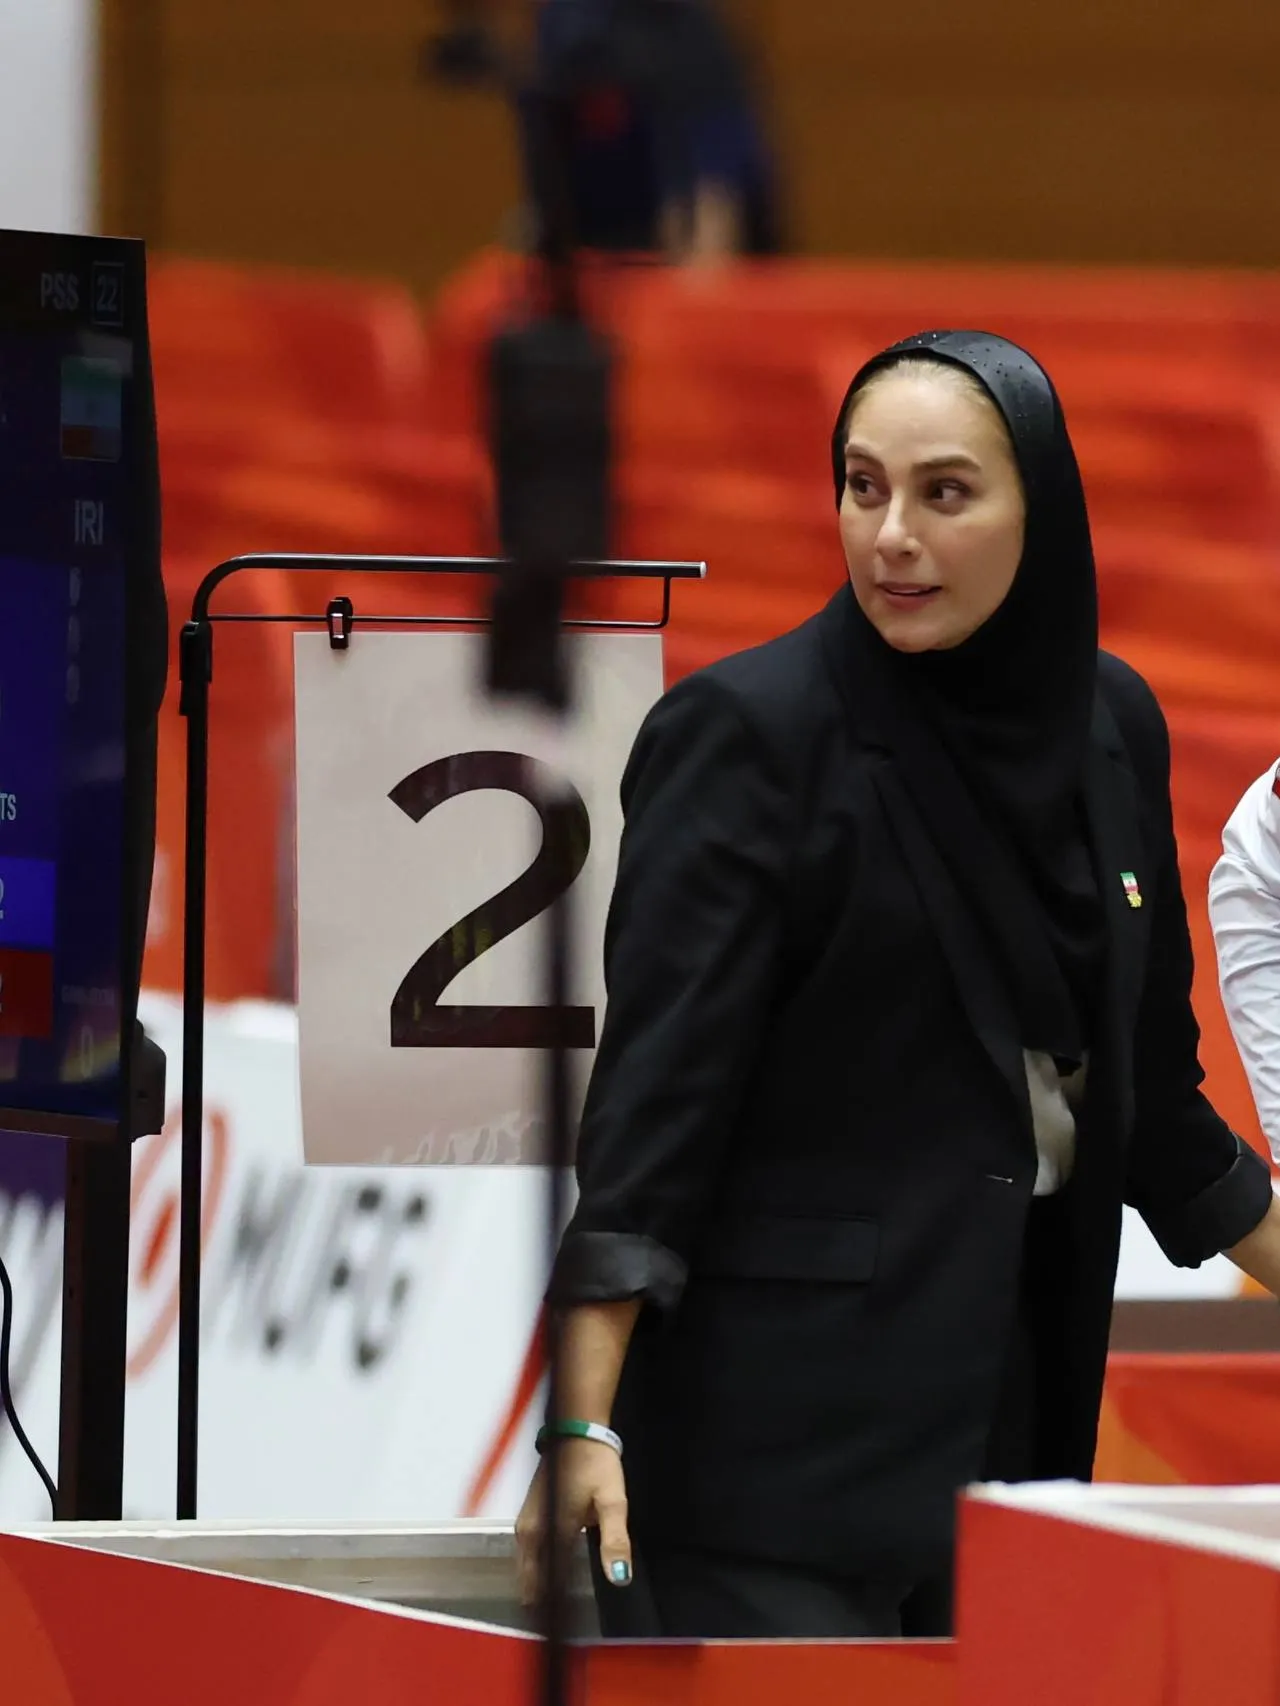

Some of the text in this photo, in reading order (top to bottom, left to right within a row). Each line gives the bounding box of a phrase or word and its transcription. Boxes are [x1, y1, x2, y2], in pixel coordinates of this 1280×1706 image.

[41, 273, 119, 313] PSS 22
[74, 500, 104, 545] IRI
[387, 750, 595, 1048] 2
